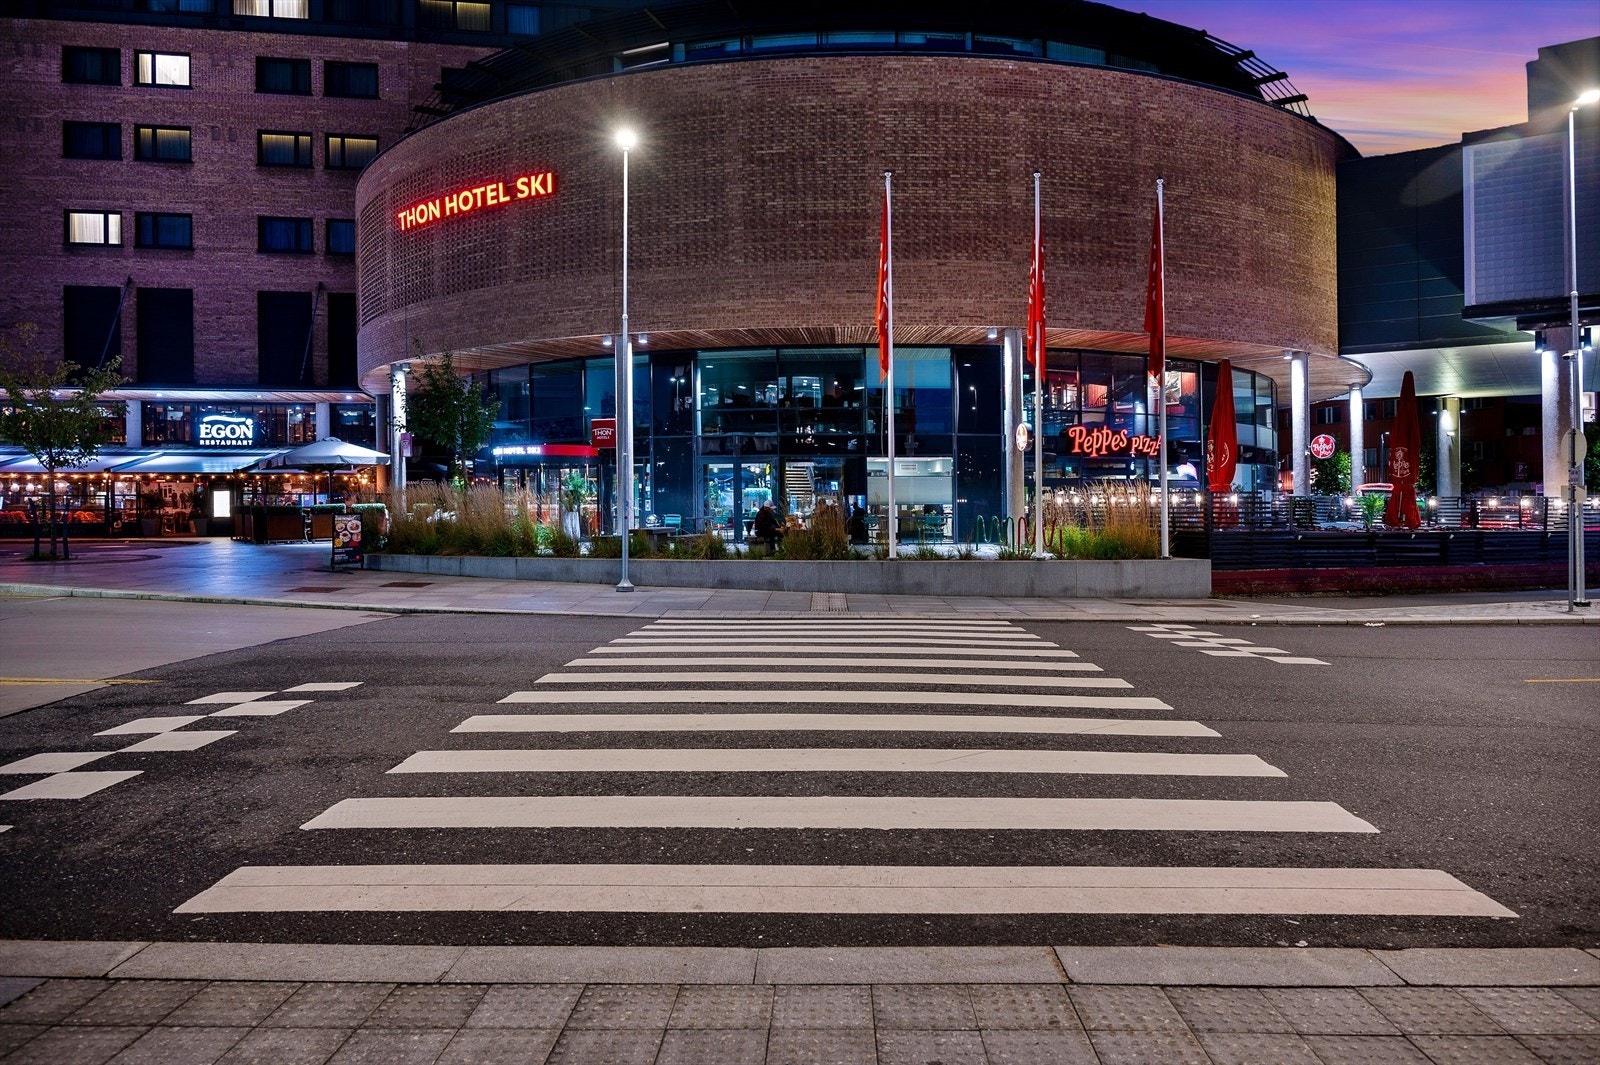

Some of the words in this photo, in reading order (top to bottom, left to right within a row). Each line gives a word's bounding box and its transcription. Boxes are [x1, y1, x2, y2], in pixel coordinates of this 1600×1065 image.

[398, 199, 440, 231] THON
[445, 182, 510, 216] HOTEL
[516, 172, 553, 199] SKI
[199, 422, 254, 439] EGON
[592, 427, 614, 436] THON
[1069, 424, 1128, 457] Peppes
